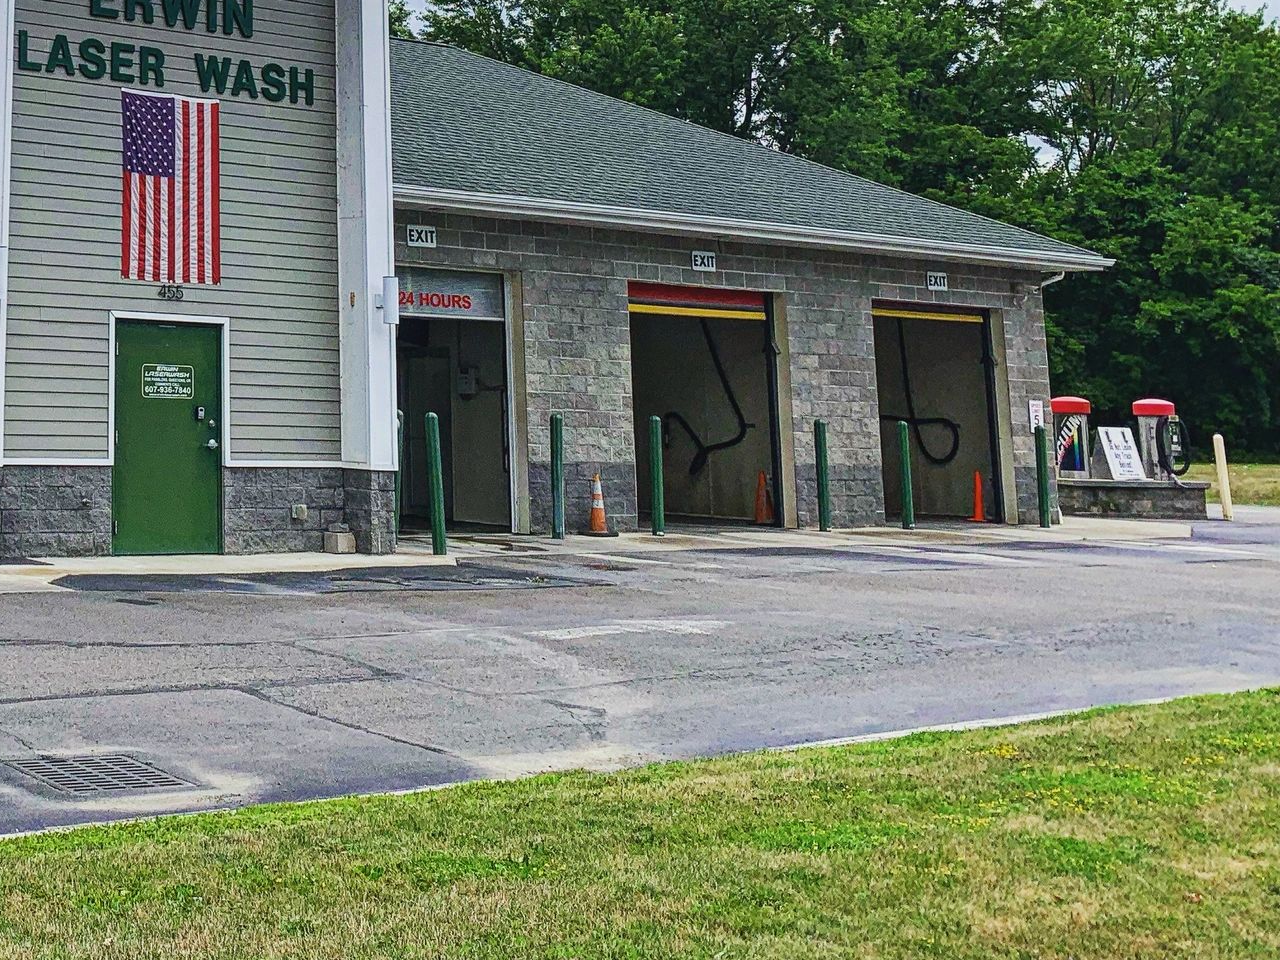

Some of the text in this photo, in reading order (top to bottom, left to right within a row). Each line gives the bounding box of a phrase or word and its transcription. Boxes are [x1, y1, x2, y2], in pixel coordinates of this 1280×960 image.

[18, 29, 314, 106] LASER WASH
[408, 228, 435, 243] EXIT
[693, 254, 715, 268] EXIT
[928, 275, 946, 287] EXIT
[157, 284, 184, 300] 455
[398, 291, 472, 310] 24 HOURS
[1034, 415, 1040, 425] 5
